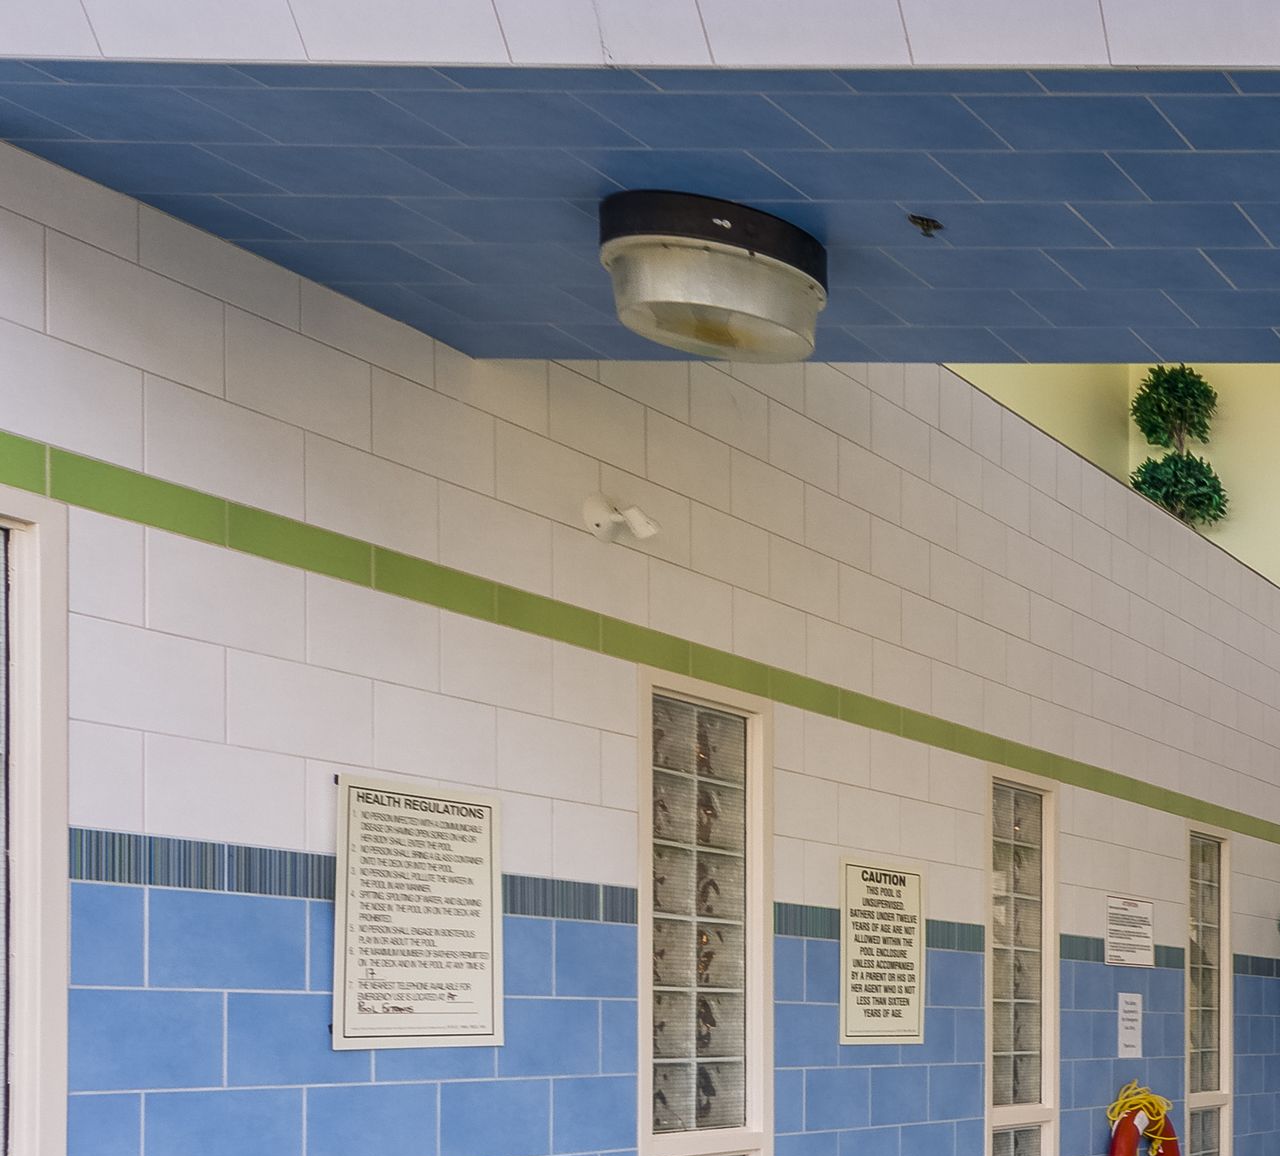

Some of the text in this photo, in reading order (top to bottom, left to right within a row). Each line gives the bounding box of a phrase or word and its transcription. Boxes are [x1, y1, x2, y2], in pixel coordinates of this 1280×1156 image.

[356, 790, 484, 820] HEALTH REGULATIONS
[861, 870, 906, 887] CAUTION
[866, 885, 901, 898] THIS POOL IS
[849, 908, 917, 924] BATHERS UNDER TWELVE
[851, 921, 915, 935] YEARS OF AGE ARE NOT
[854, 934, 913, 947] ALLOWED WITHIN THE
[859, 947, 907, 958] POOL ENCLOSURE
[852, 958, 914, 970] UNLESS ACCOMPANIED
[850, 971, 915, 982] BY A PARENT OR HIS OR
[850, 983, 915, 994] HER AGENT WHO IS NOT
[856, 996, 910, 1006] LESS THAN SIXTEEN
